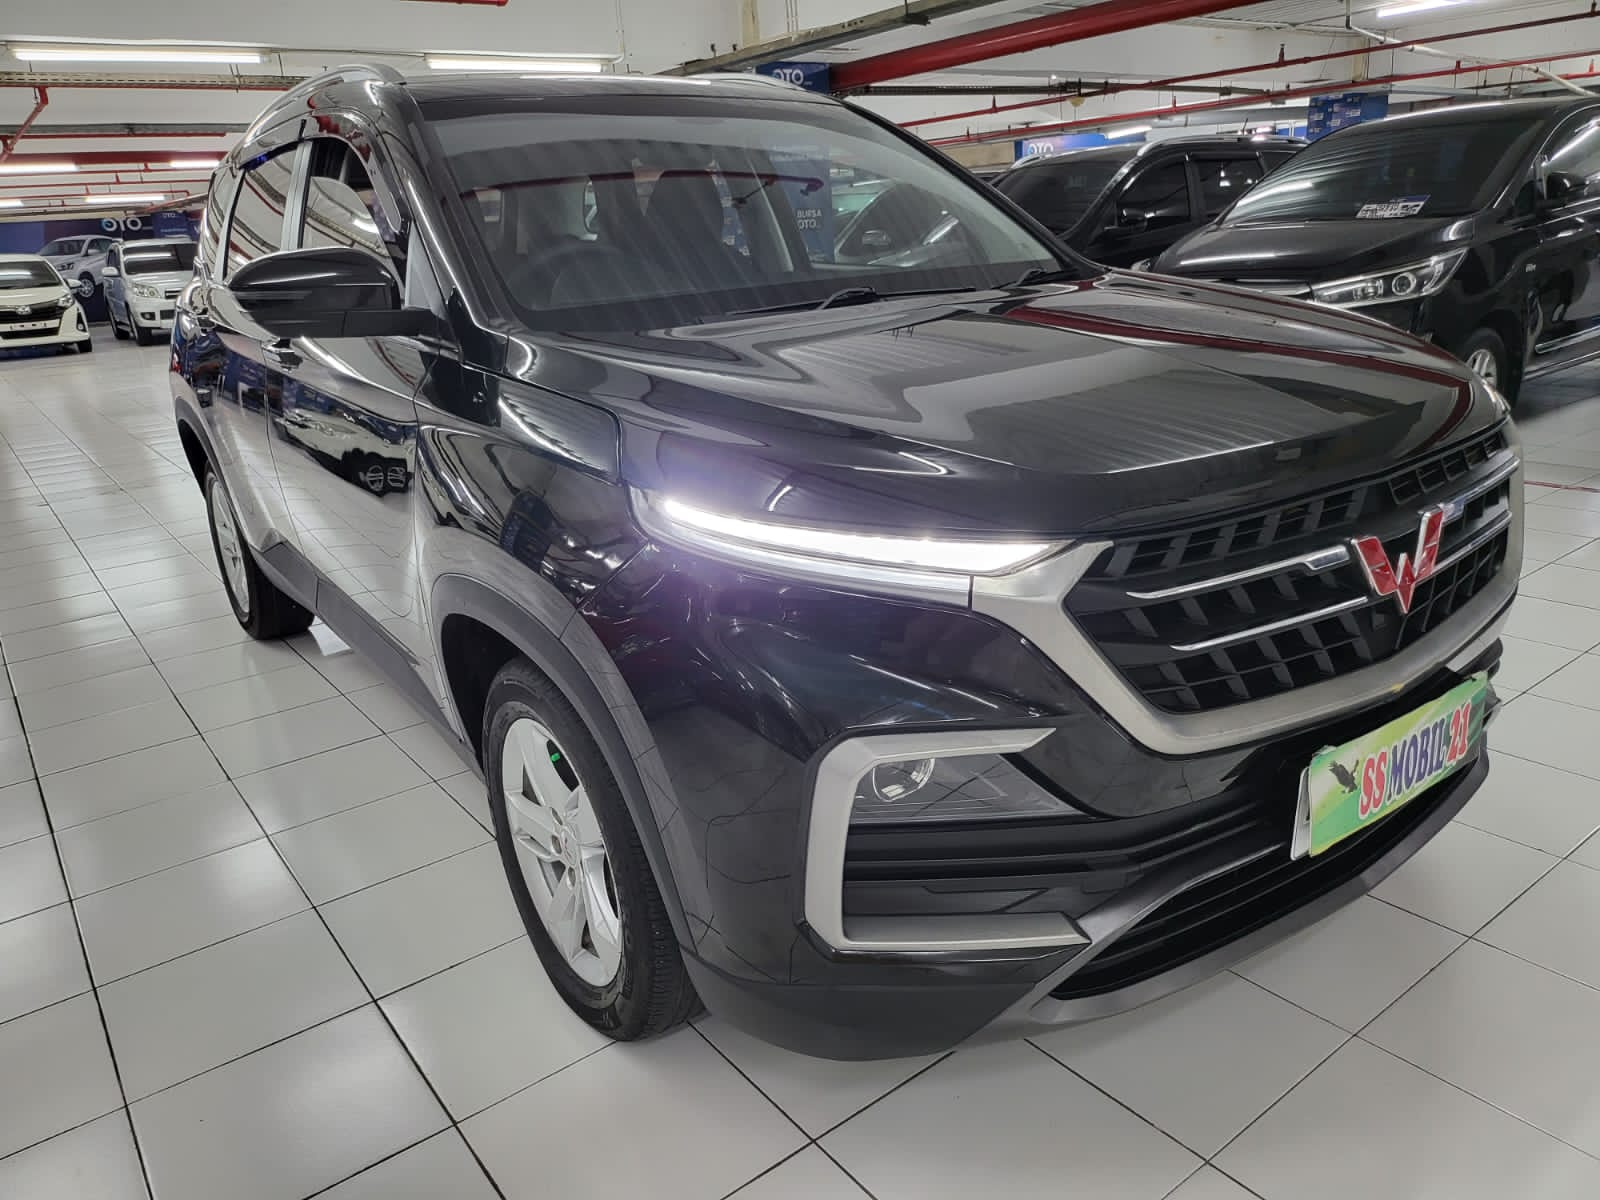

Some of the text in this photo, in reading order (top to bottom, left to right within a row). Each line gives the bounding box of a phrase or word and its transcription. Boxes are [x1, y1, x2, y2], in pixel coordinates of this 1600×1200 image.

[772, 68, 804, 85] OTO
[101, 216, 142, 232] OTO
[1359, 702, 1471, 817] SS MOBIL 21
